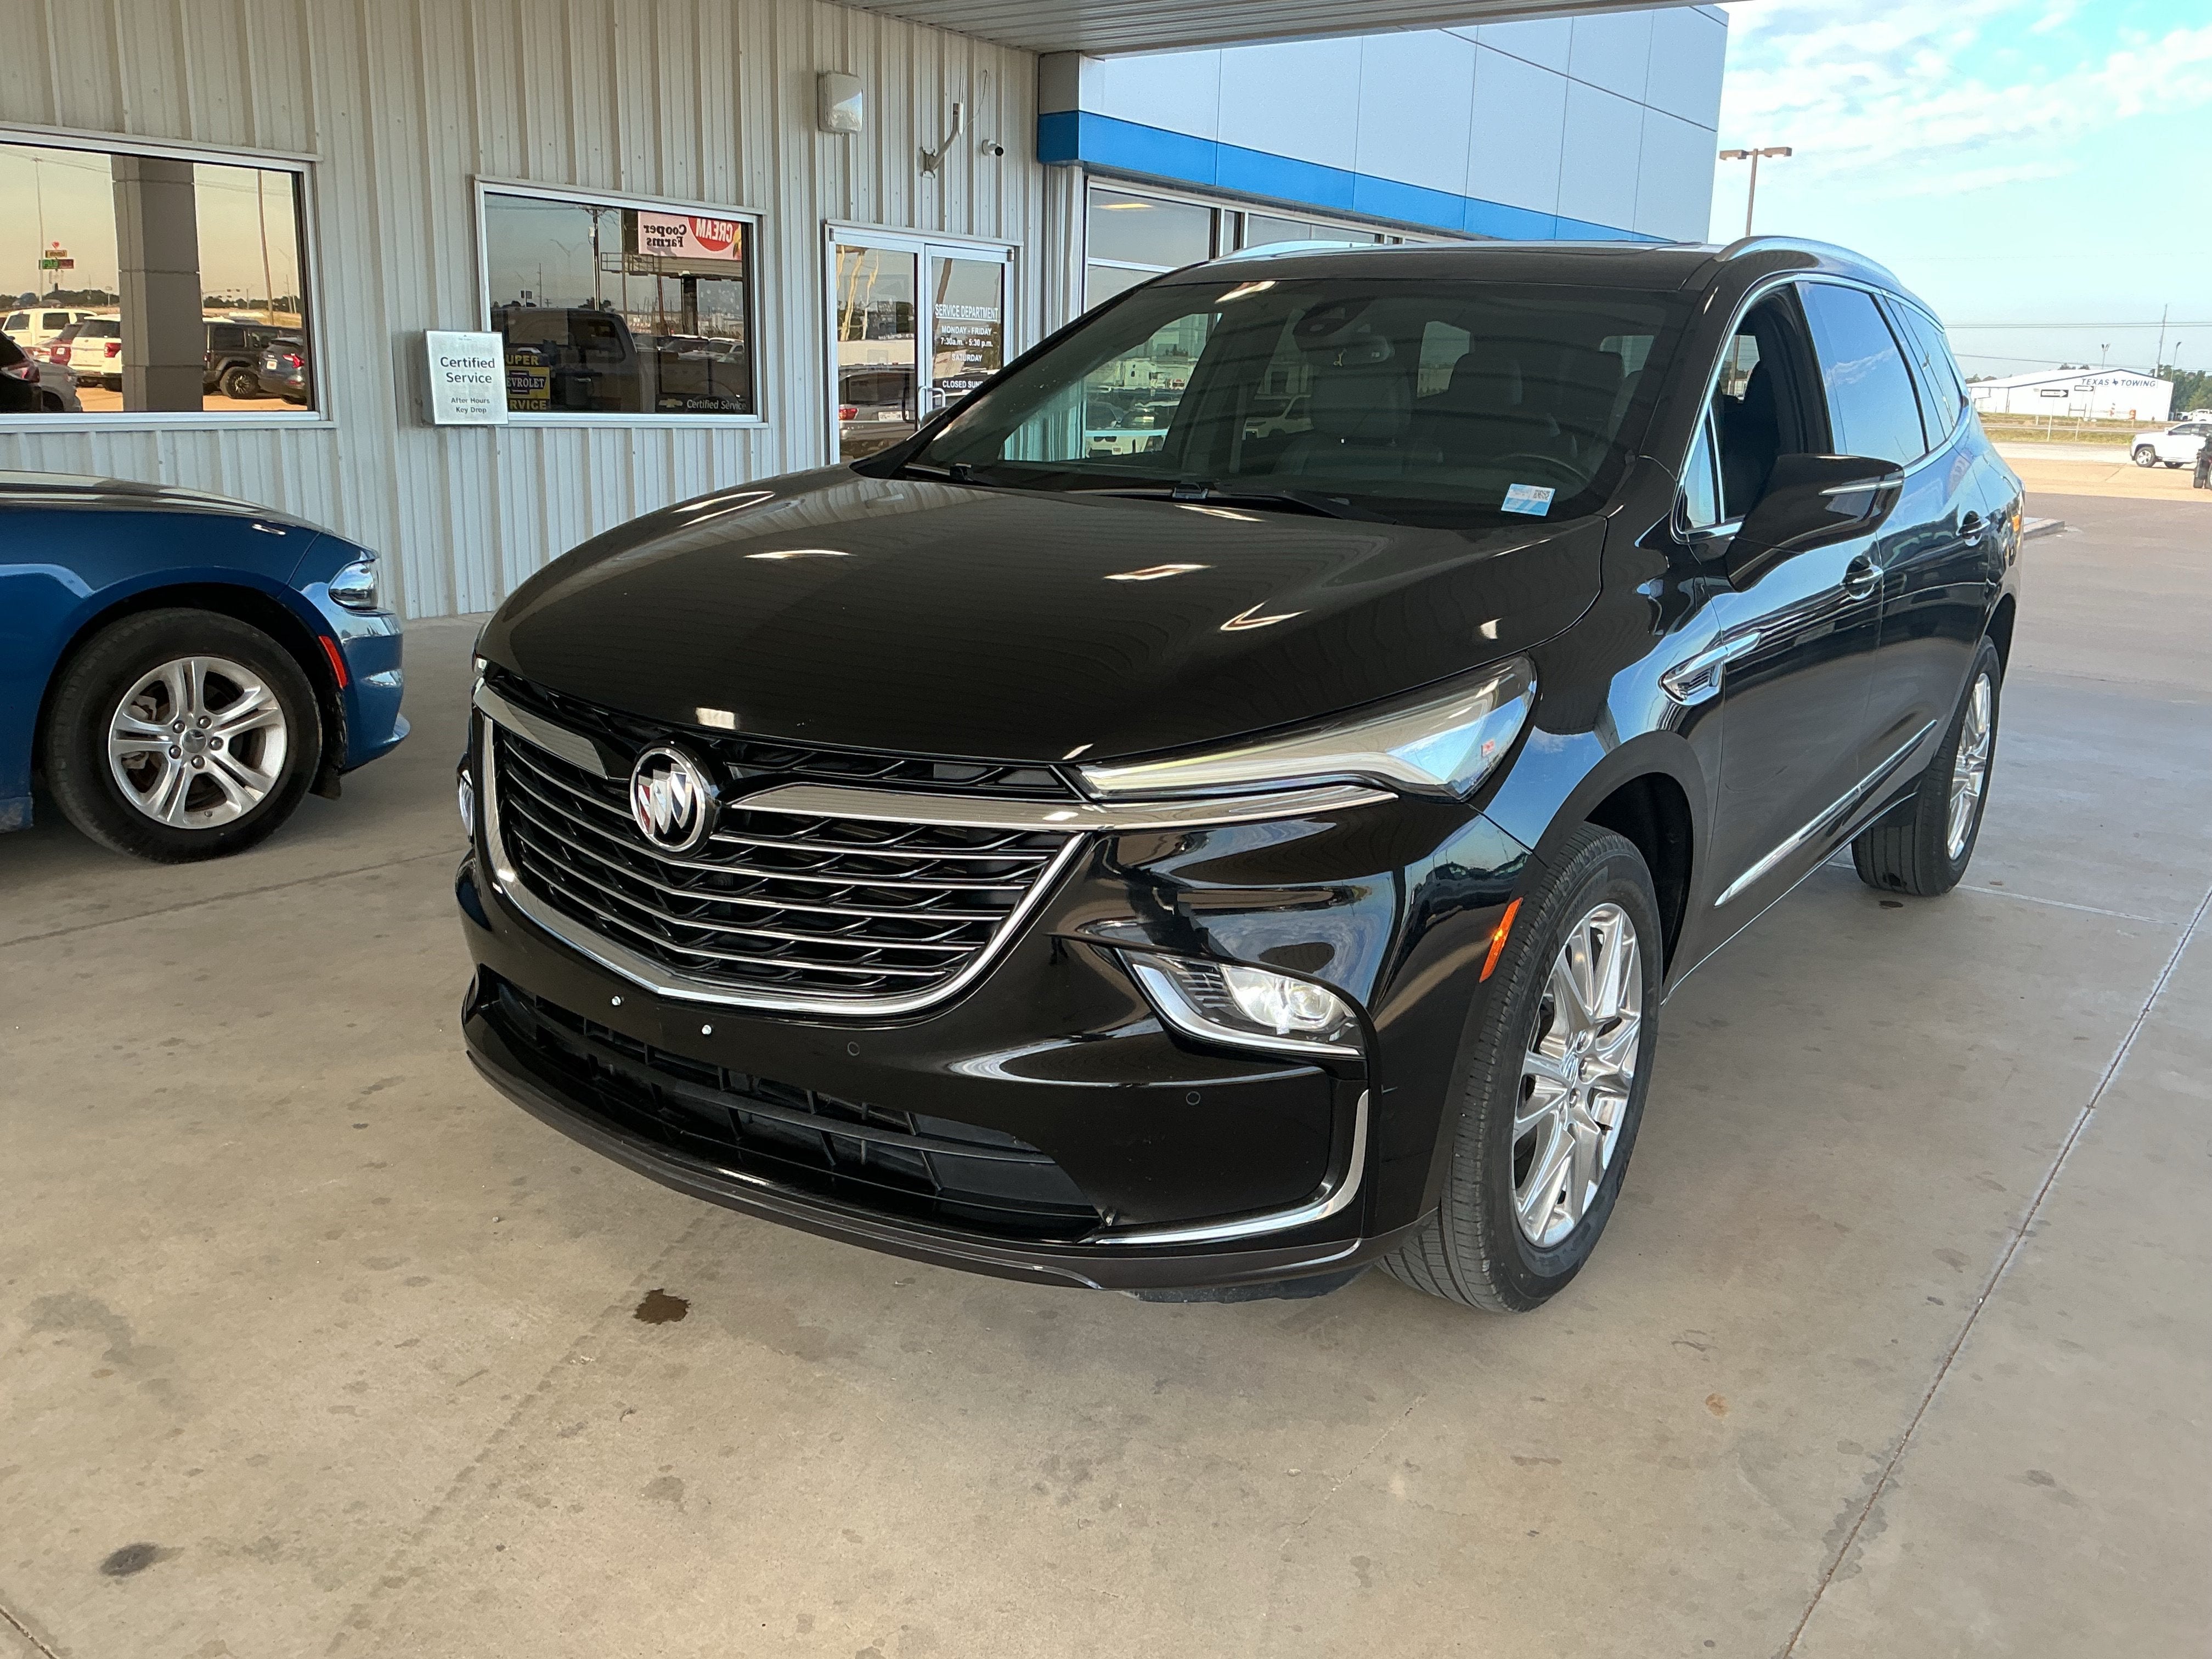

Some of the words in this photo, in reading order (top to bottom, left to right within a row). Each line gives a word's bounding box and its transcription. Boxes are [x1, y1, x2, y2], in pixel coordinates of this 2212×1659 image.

[935, 303, 960, 318] SERVICE
[961, 305, 998, 319] DEPARTMENT
[941, 325, 967, 334] MONDAY
[971, 327, 992, 336] FRIDAY
[968, 338, 980, 347] 5:30
[440, 357, 495, 368] Certified
[506, 354, 539, 365] UPER
[951, 354, 983, 362] SATURDAY
[446, 372, 492, 383] Service
[506, 377, 545, 388] EVROLET
[942, 380, 967, 388] CLOSED
[509, 399, 546, 410] RVICE
[686, 399, 719, 409] Certified
[720, 400, 747, 410] Service
